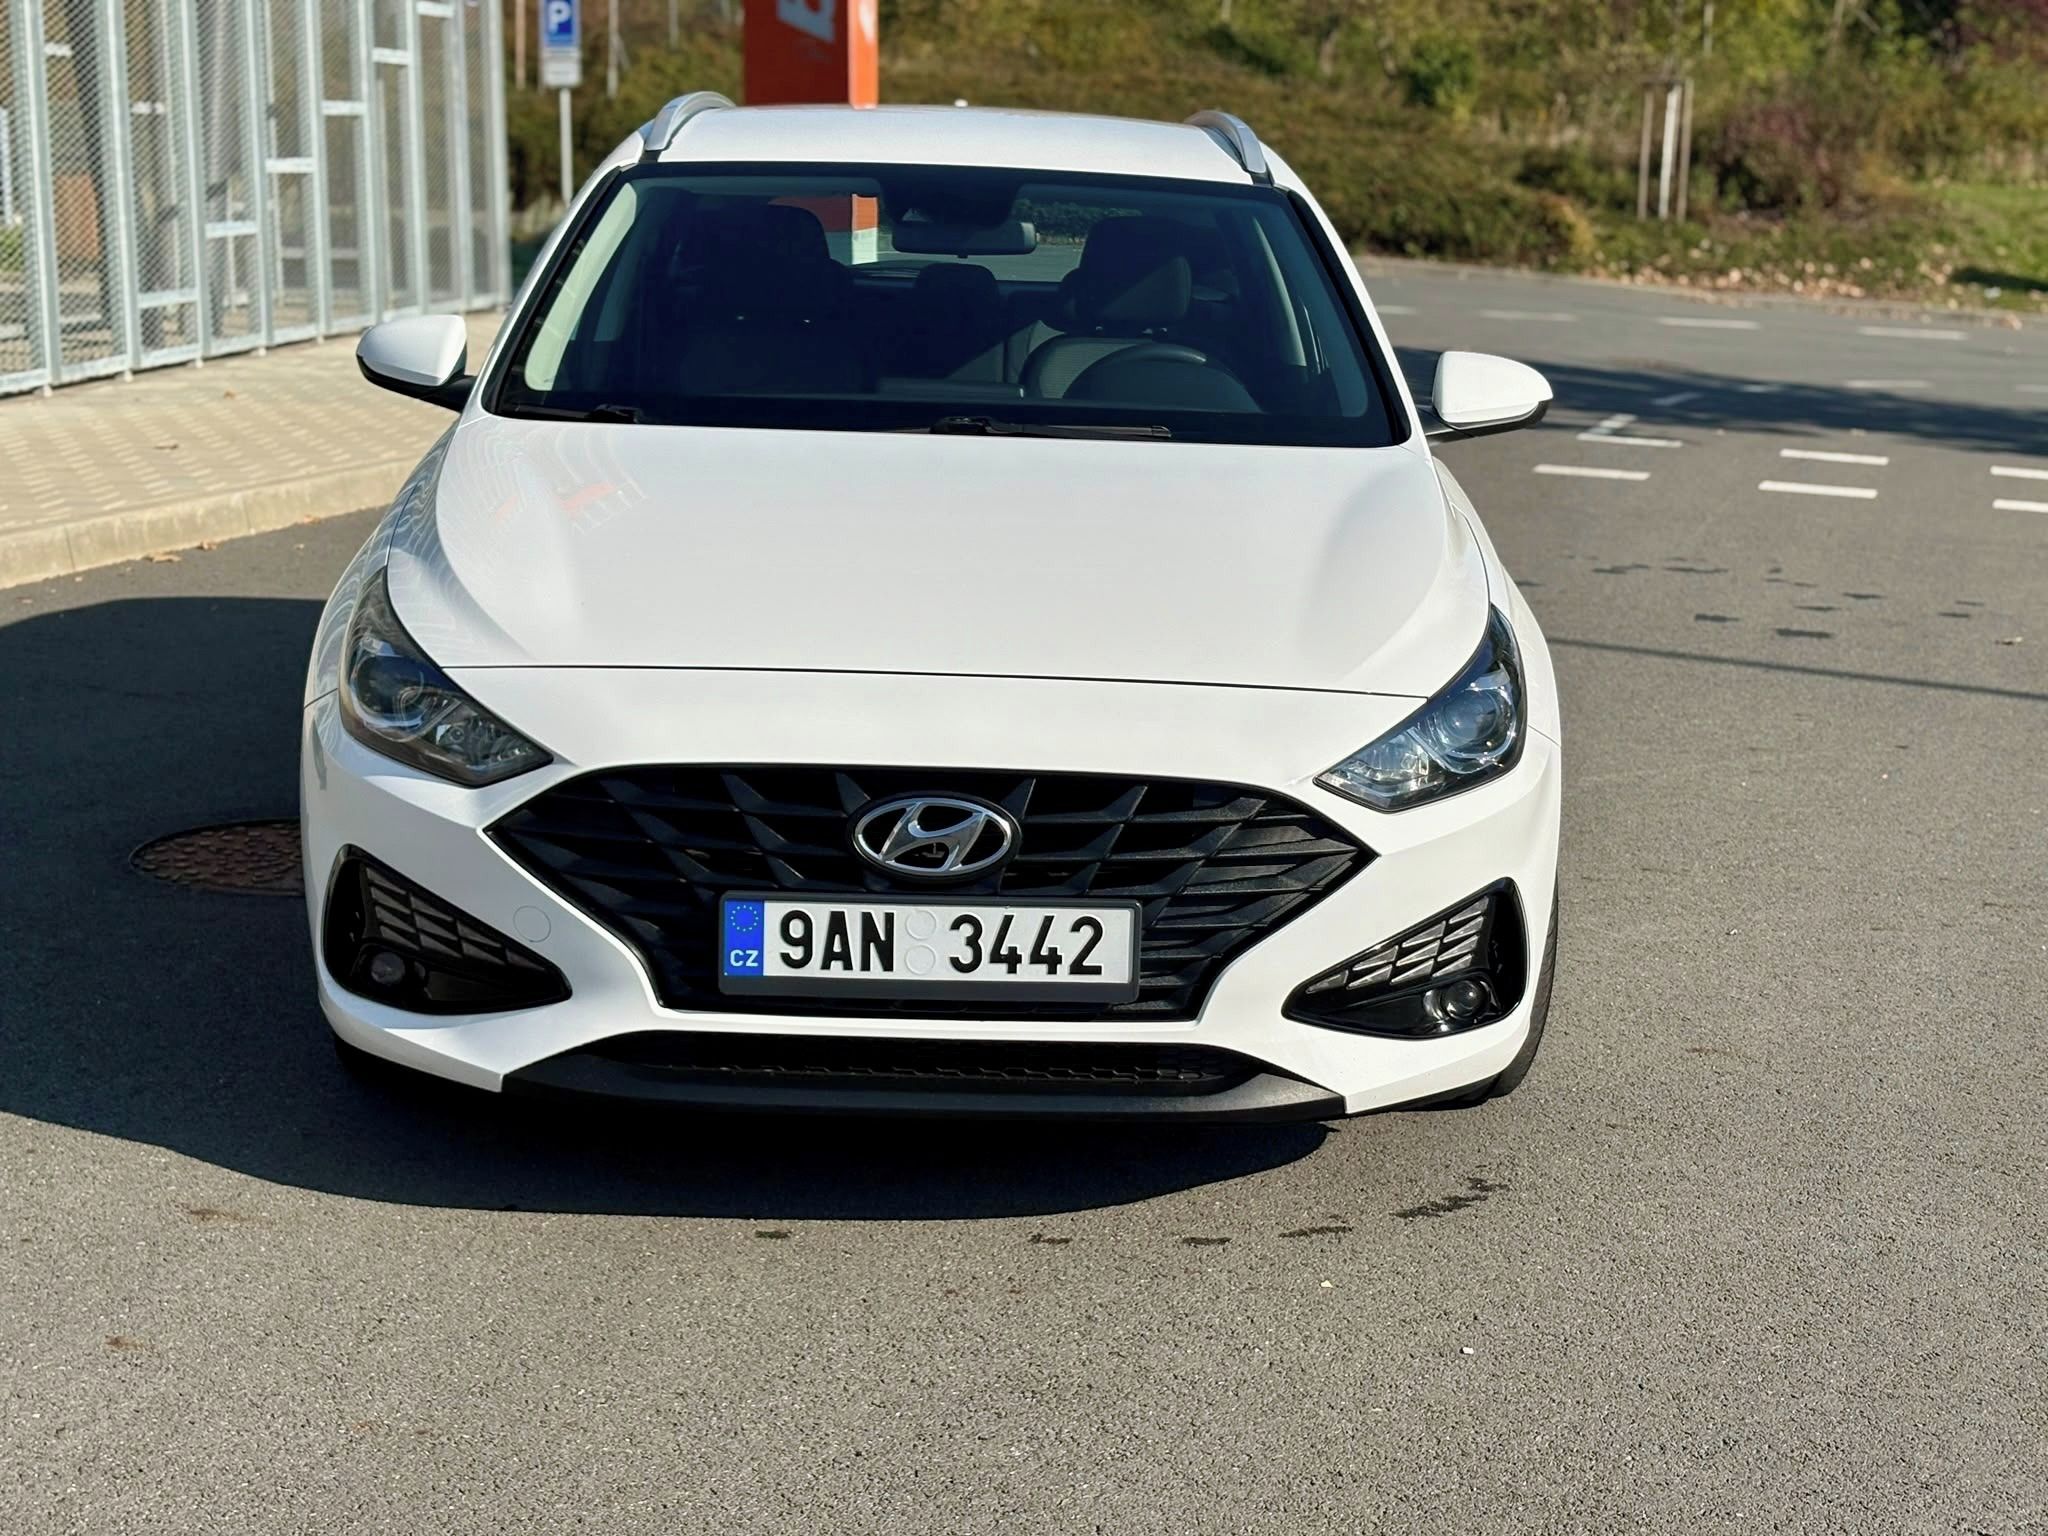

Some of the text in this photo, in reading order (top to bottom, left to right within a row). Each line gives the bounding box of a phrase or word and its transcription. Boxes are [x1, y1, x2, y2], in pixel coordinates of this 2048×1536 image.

[548, 1, 571, 34] P
[729, 949, 759, 968] CZ
[779, 909, 1104, 976] 9AN 3442
